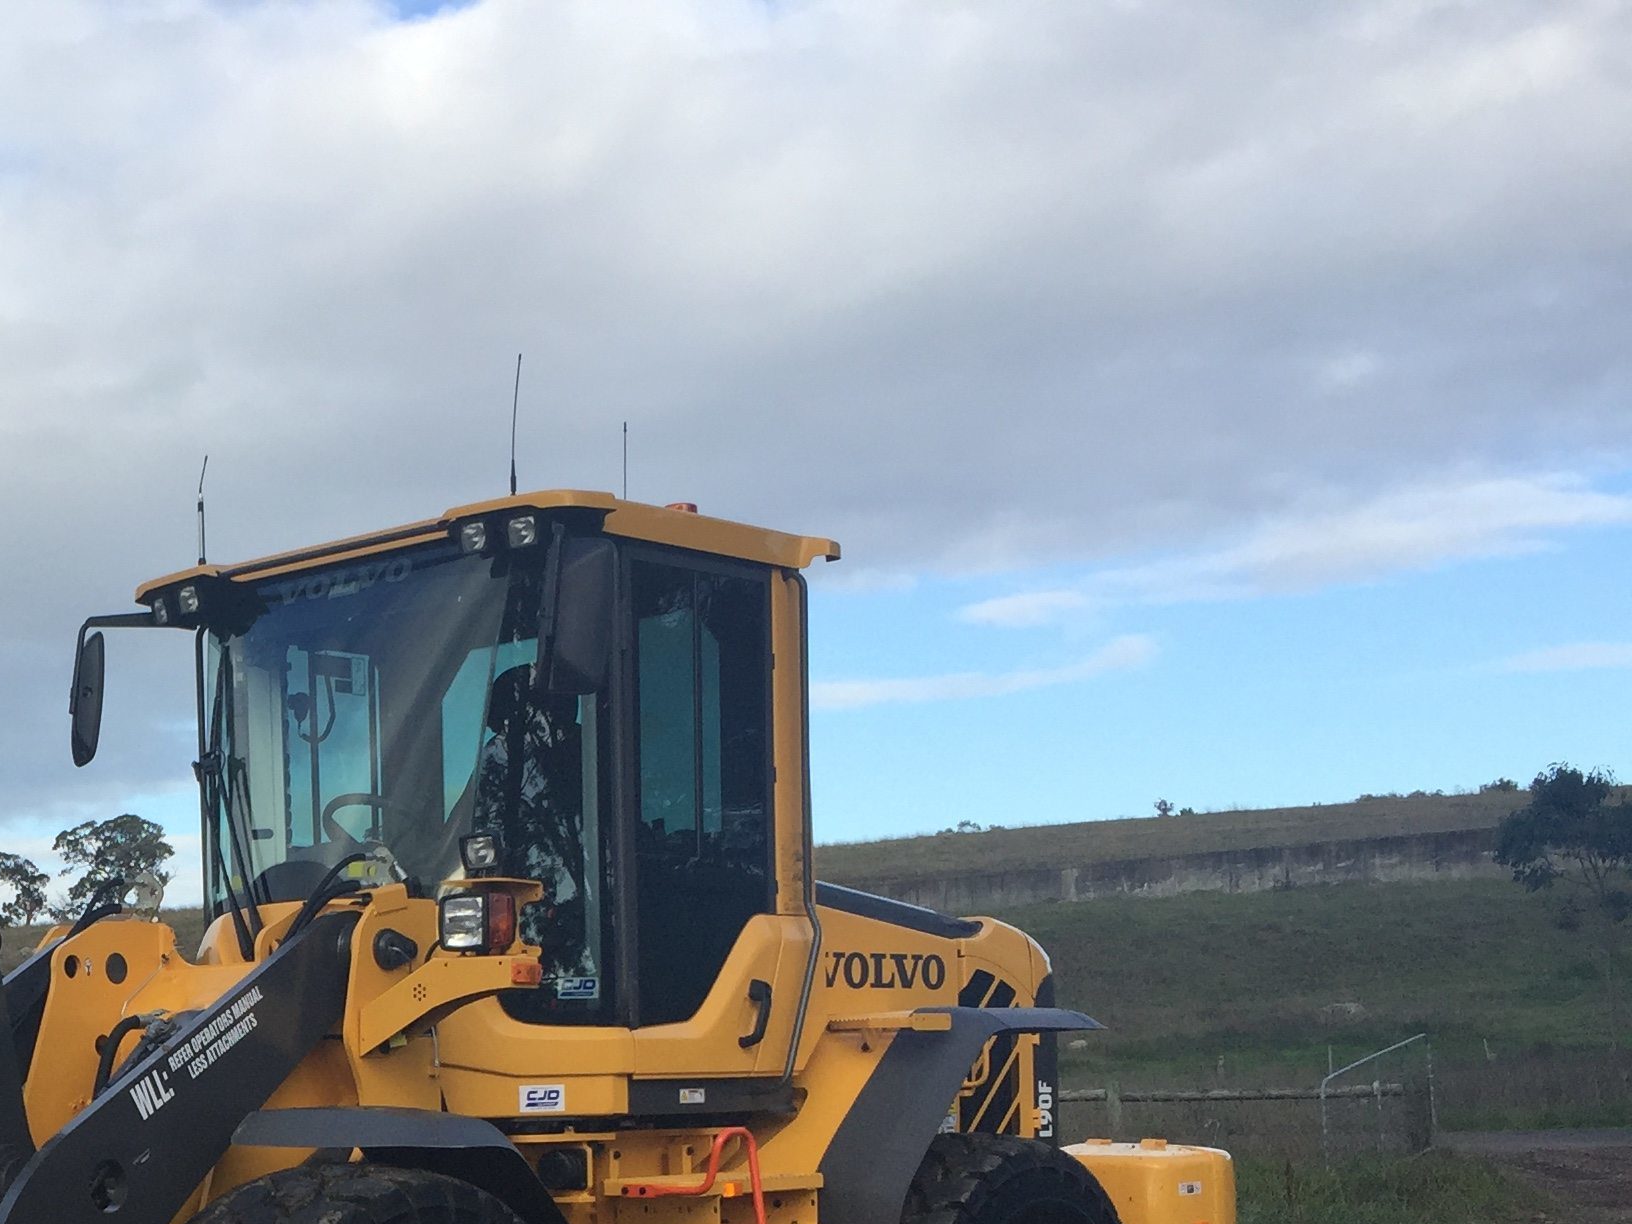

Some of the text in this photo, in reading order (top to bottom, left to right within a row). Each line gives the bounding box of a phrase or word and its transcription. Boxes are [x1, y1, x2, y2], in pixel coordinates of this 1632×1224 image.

[825, 952, 945, 990] VOLVO
[130, 986, 264, 1121] WLL: REFER OPERATORS MANUAL
[188, 1013, 258, 1080] LESS ATTACHMENTS
[527, 1090, 560, 1101] CJD
[1038, 1080, 1053, 1138] L90F
